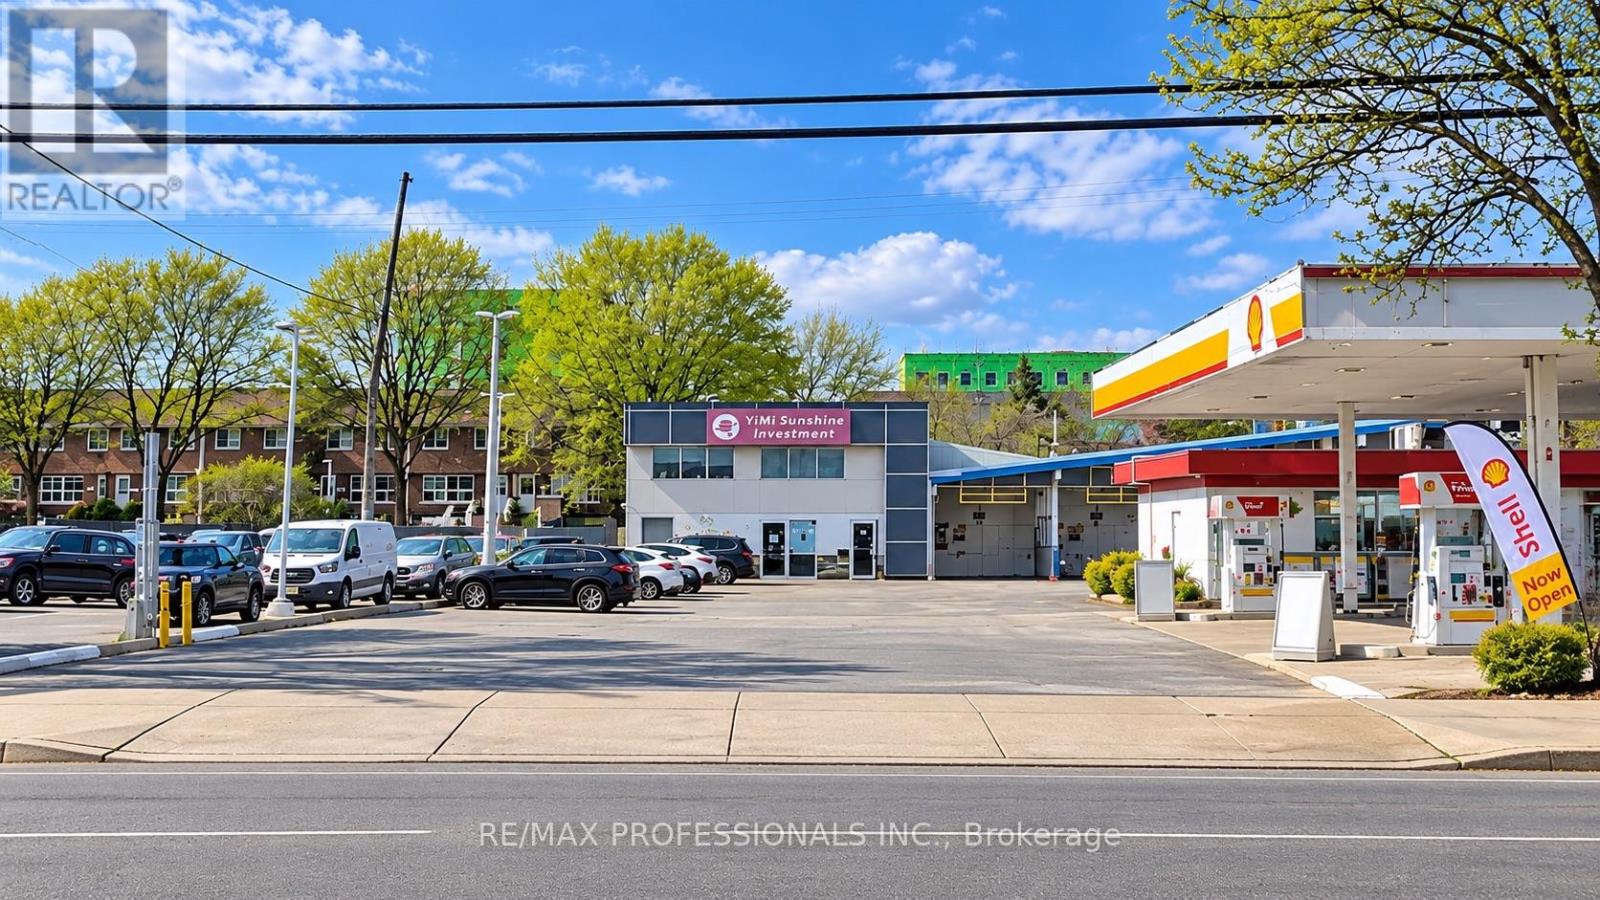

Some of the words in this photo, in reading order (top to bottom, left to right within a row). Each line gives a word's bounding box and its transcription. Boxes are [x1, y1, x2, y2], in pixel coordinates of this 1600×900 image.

[745, 415, 776, 425] YiMi
[780, 414, 845, 426] Sunshine
[753, 428, 835, 439] Investment
[1497, 493, 1540, 559] Shell
[1522, 567, 1562, 595] Now
[1527, 583, 1573, 612] Open
